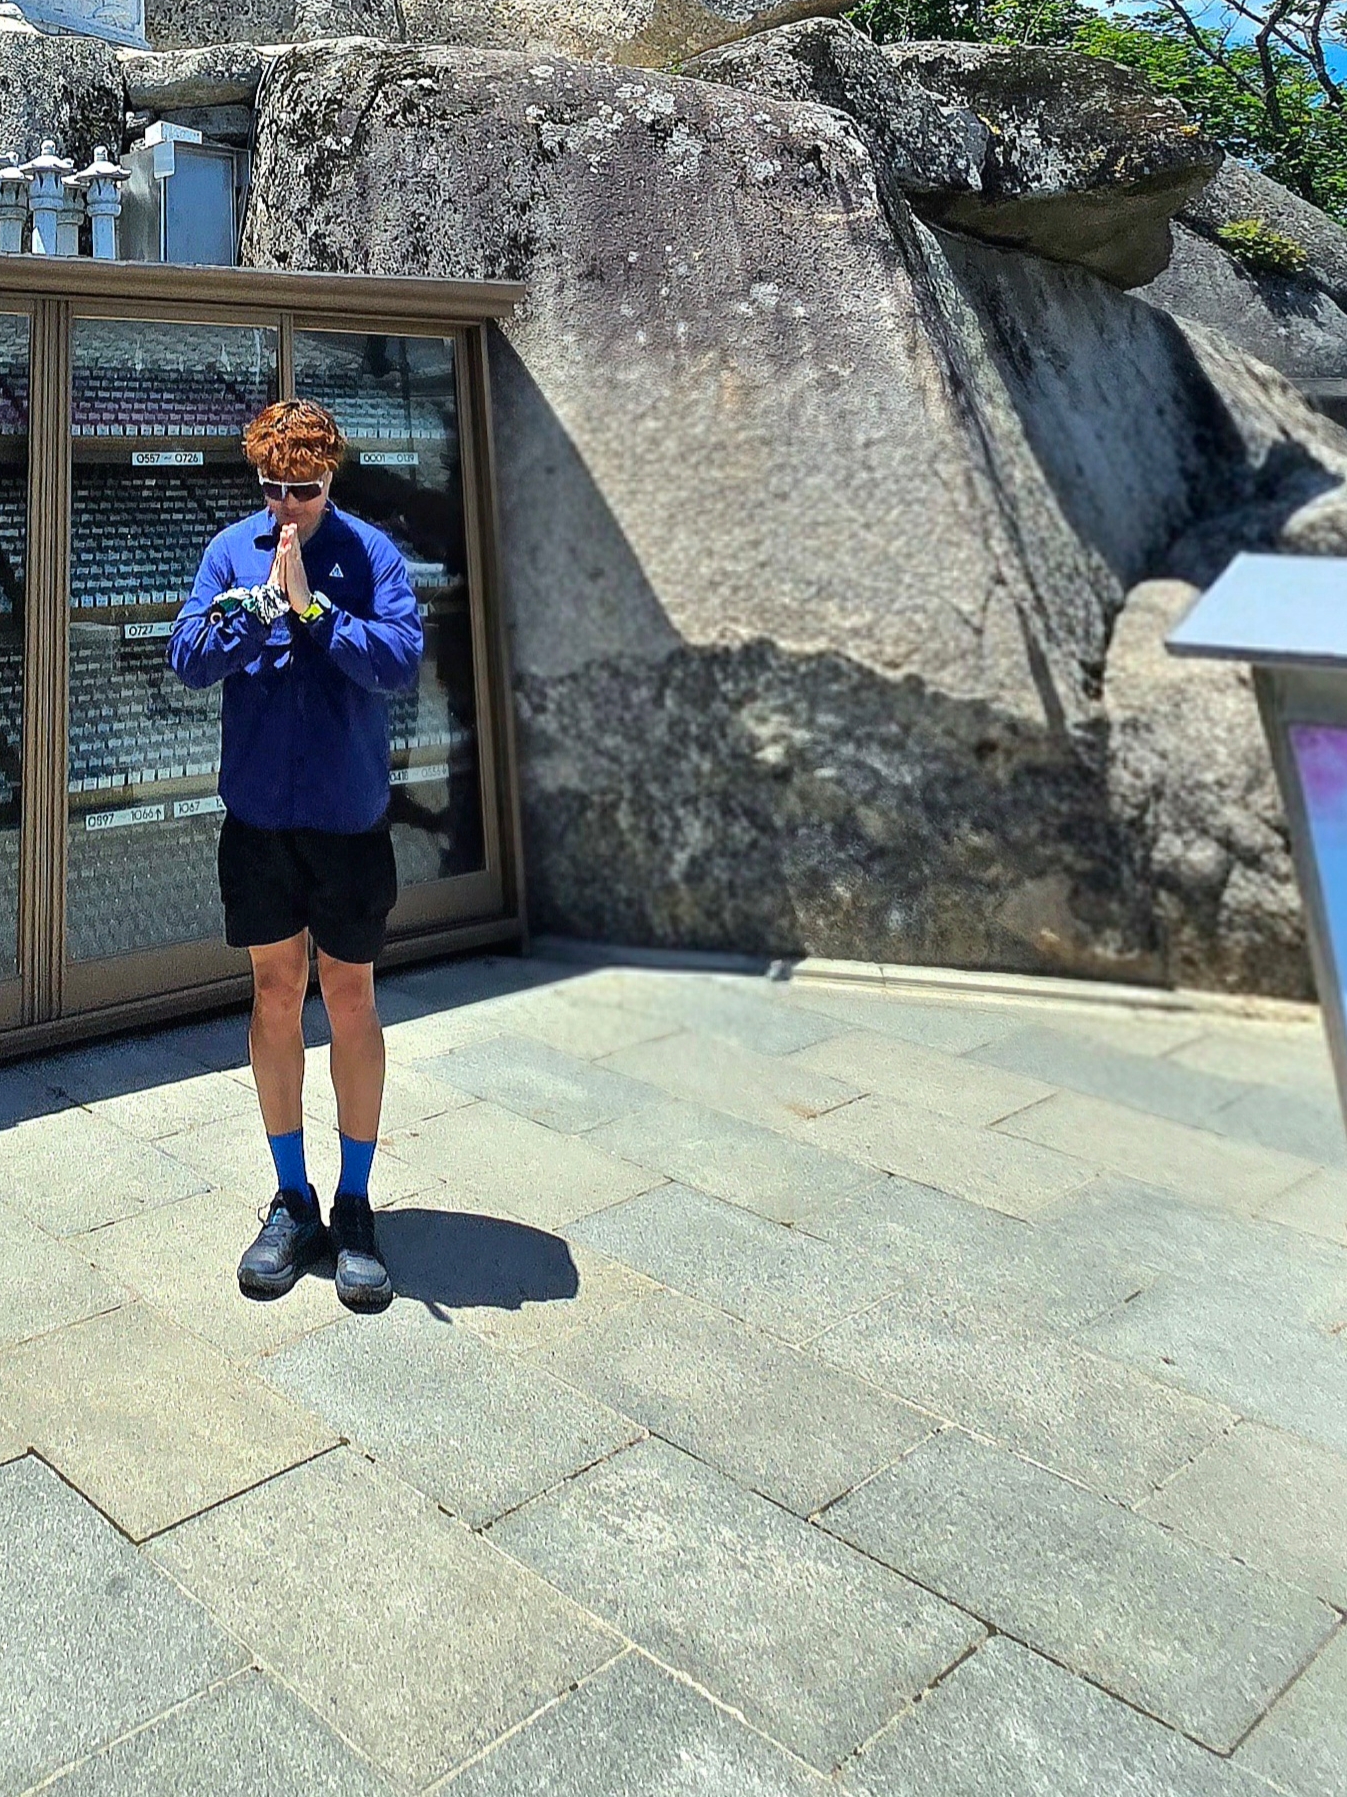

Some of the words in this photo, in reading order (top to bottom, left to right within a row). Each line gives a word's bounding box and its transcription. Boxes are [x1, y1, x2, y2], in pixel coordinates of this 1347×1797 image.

[136, 454, 161, 463] 0557
[174, 453, 199, 463] 0726
[363, 453, 386, 463] 0001
[128, 624, 154, 637] 0727
[177, 801, 201, 814] 1067
[87, 812, 114, 827] 0897
[130, 808, 154, 821] 1066
